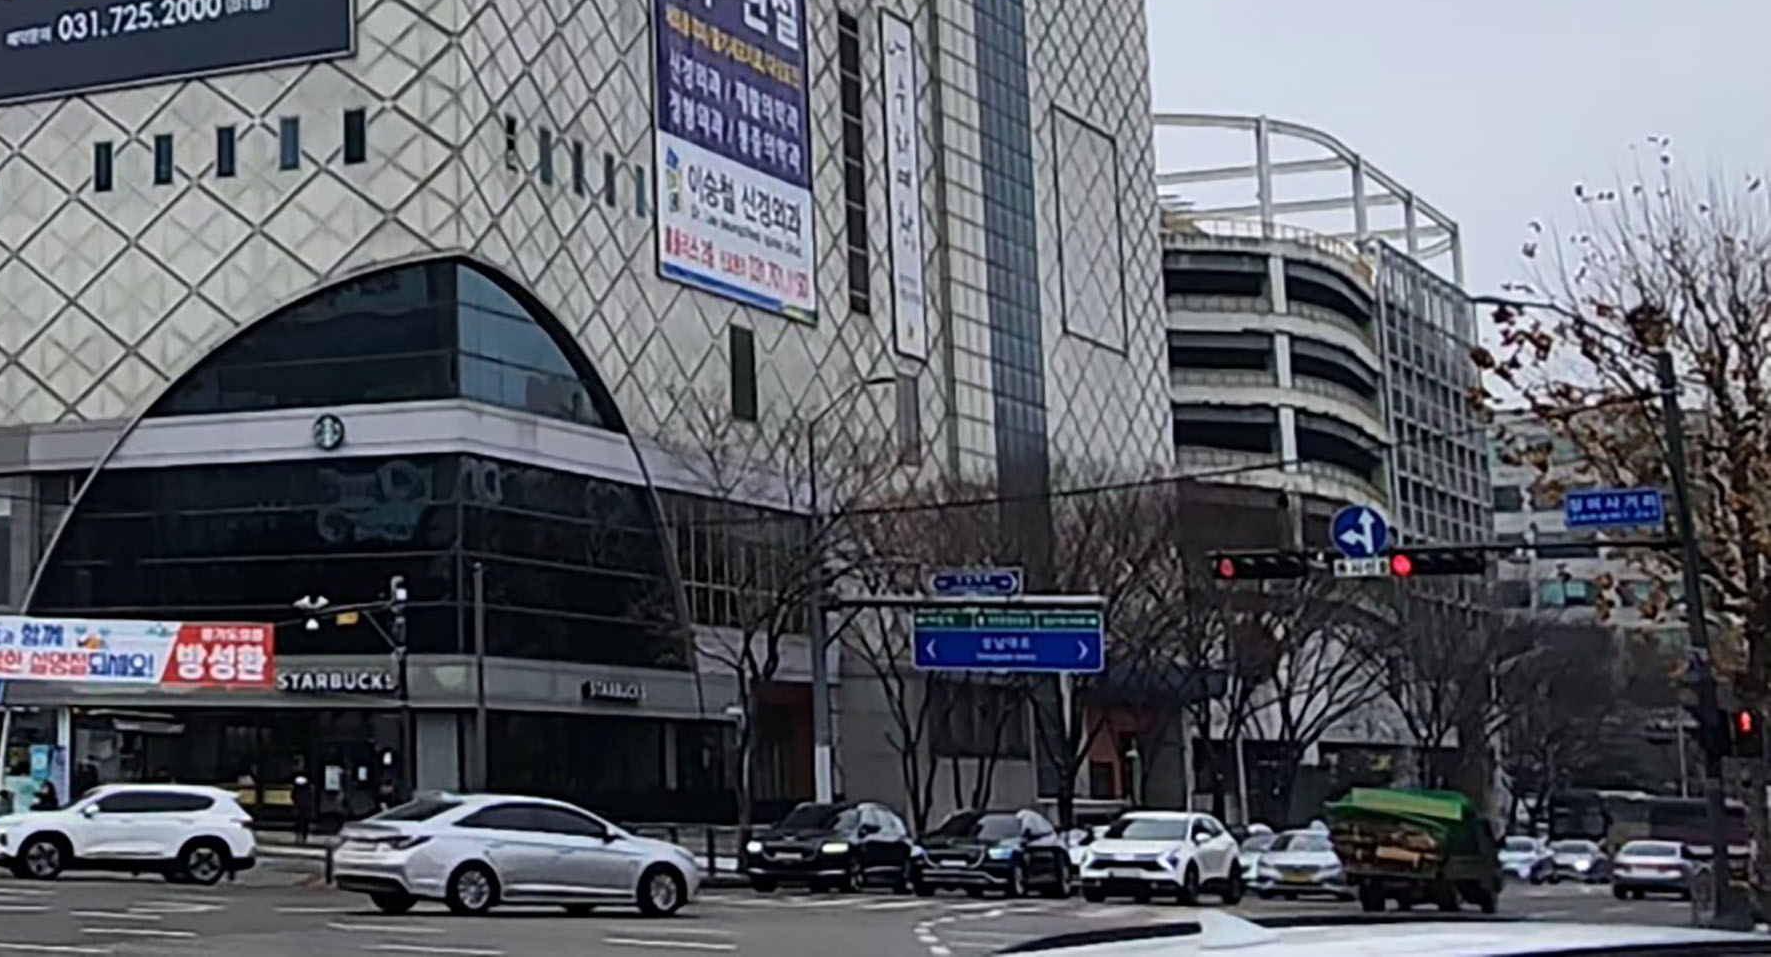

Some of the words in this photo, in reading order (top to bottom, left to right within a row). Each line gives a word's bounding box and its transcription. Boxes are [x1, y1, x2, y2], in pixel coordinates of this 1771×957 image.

[742, 184, 802, 241] 신경외과
[21, 623, 65, 647] 함께
[176, 643, 267, 681] 방성환
[276, 672, 396, 691] STARBUCKS
